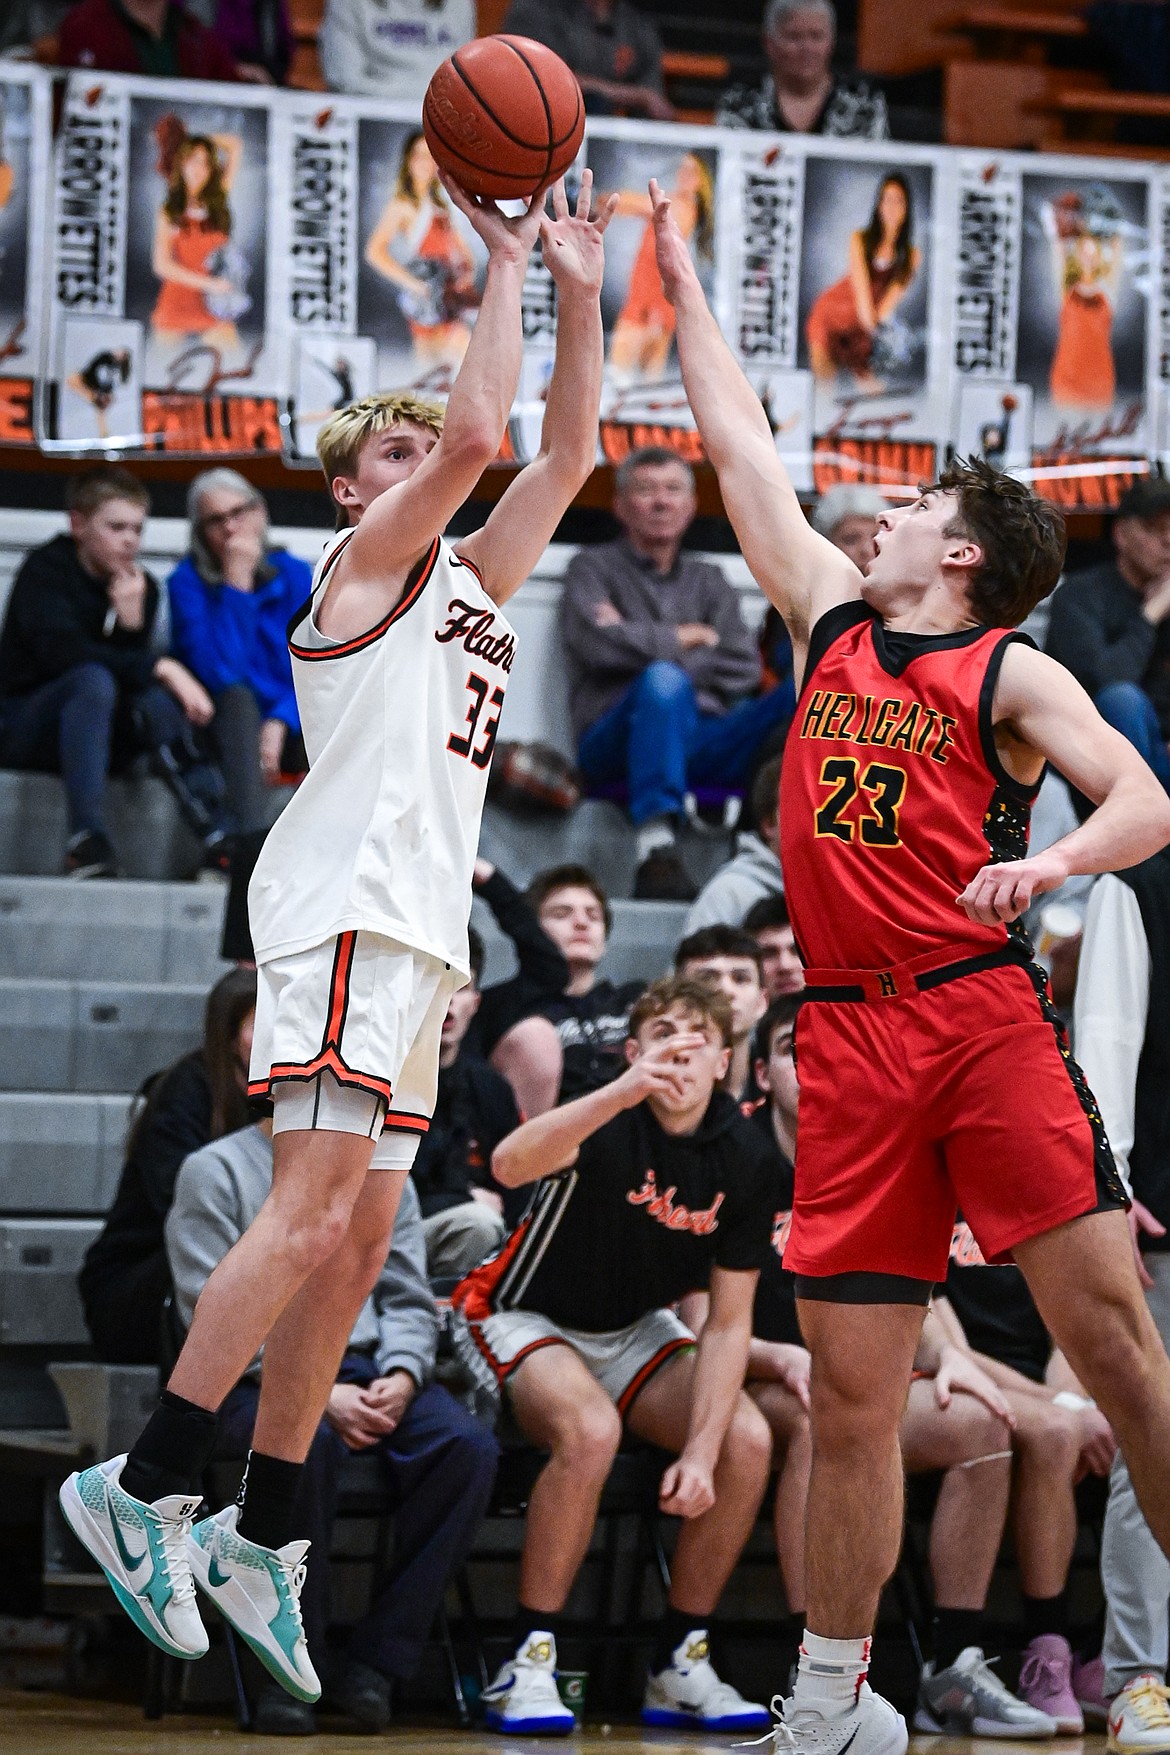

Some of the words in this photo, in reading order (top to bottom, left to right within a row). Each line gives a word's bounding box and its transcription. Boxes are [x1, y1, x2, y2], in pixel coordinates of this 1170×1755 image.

[435, 599, 516, 674] Flath
[446, 671, 505, 771] 33
[800, 690, 958, 765] HELLGATE
[814, 756, 908, 849] 23
[877, 971, 899, 997] H
